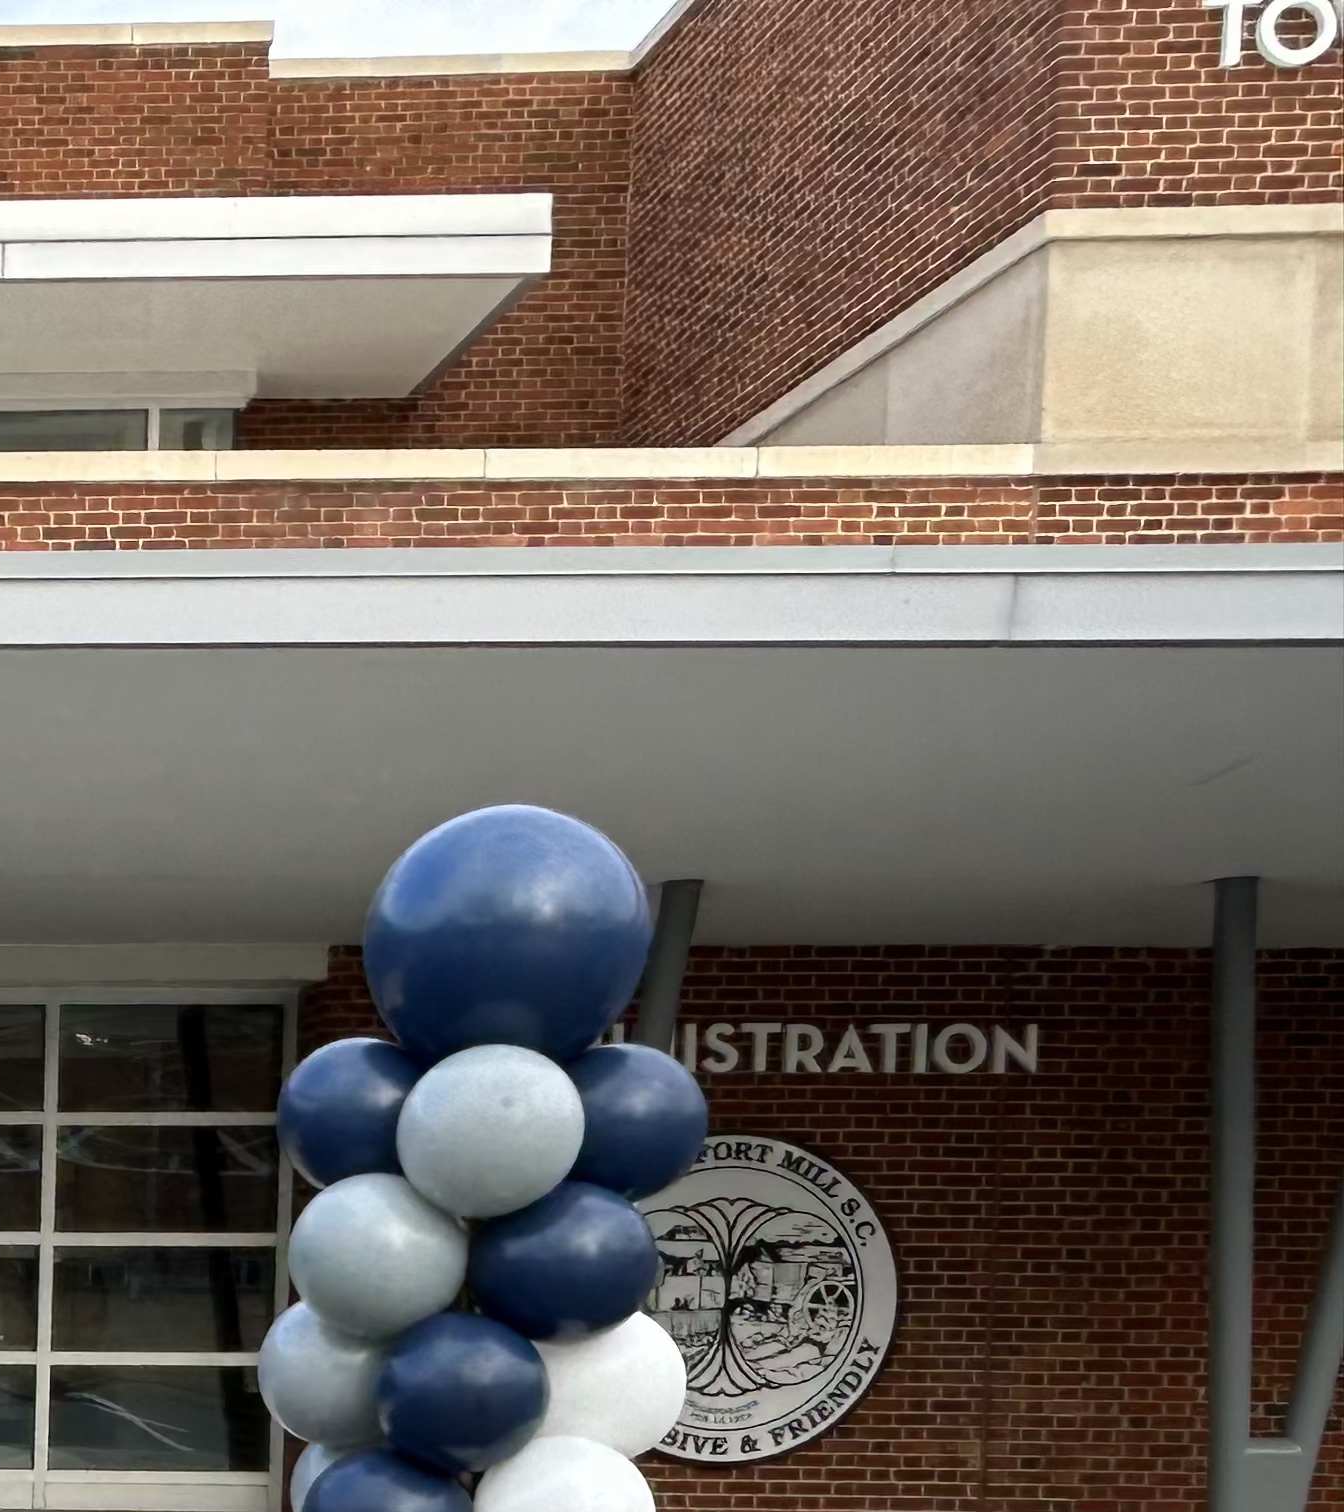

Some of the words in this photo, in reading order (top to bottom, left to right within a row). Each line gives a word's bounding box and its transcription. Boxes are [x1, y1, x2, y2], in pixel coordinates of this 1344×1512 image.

[612, 1022, 1040, 1074] ISTRATION
[777, 1149, 842, 1199] MILL
[768, 1337, 881, 1446] FRIENDLY
